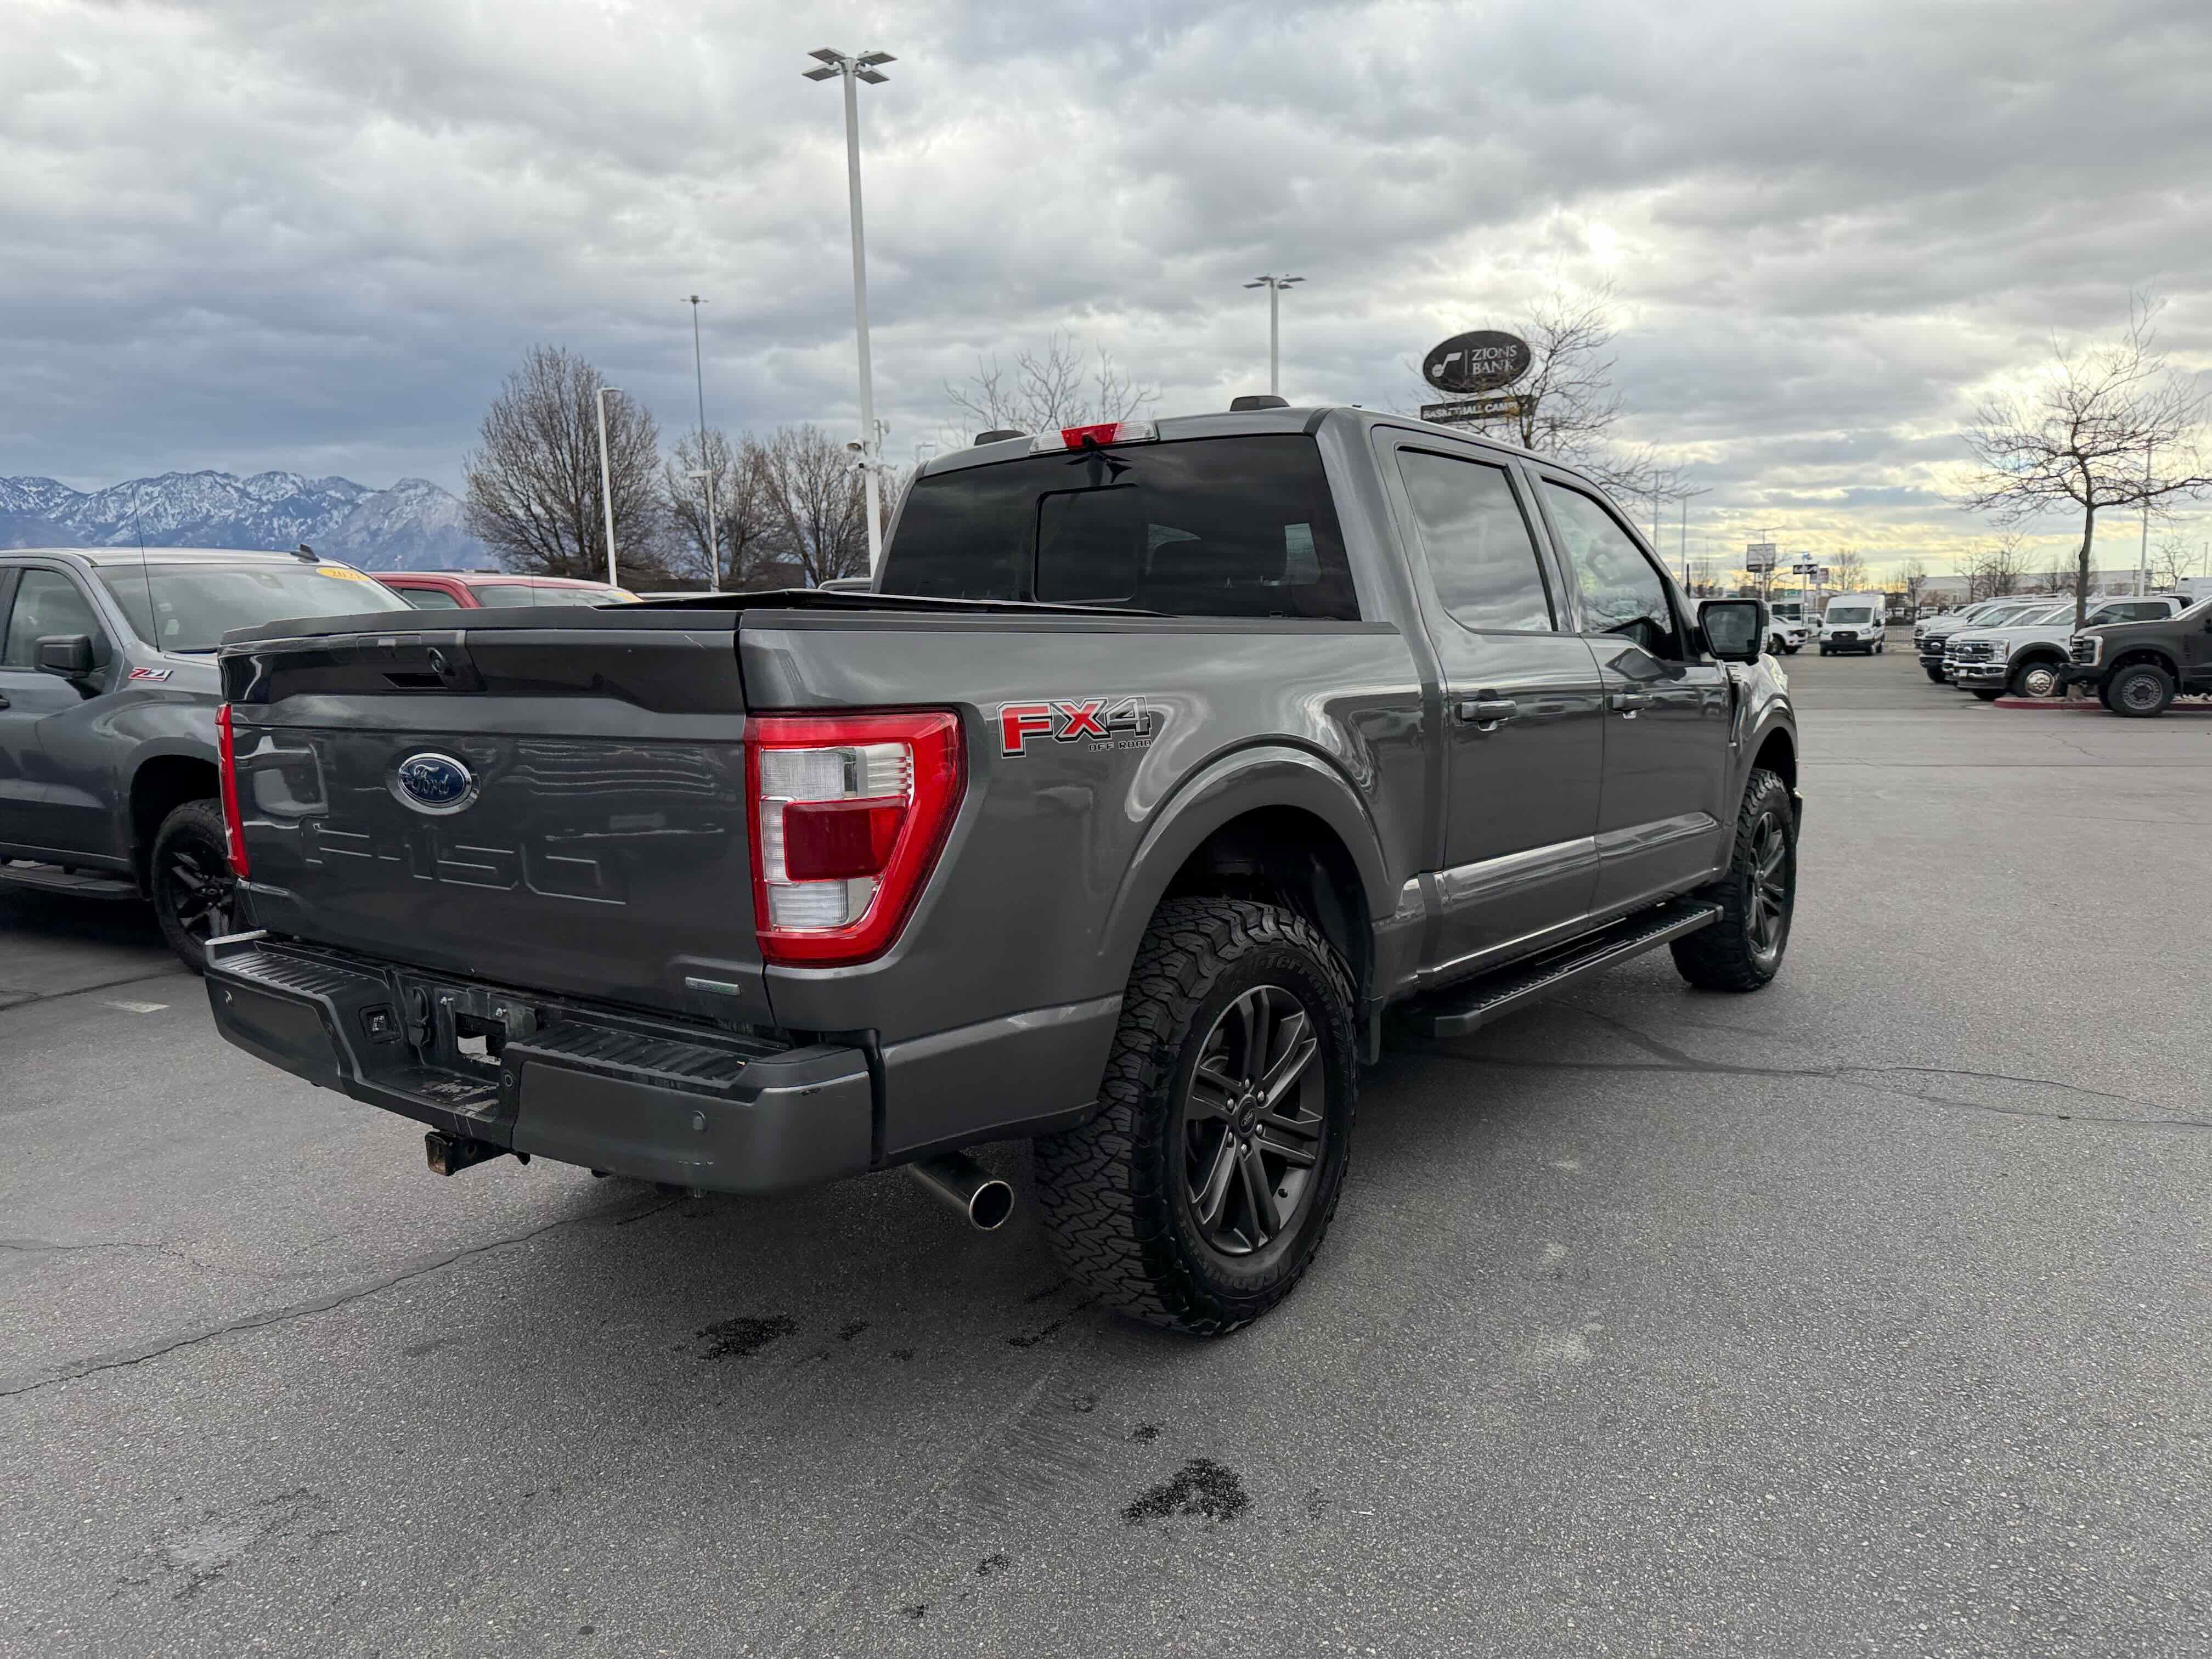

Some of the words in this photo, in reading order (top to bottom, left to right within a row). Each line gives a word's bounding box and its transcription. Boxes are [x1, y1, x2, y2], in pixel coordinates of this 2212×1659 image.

[1471, 345, 1517, 361] ZIONS
[1472, 359, 1514, 375] BANK
[996, 695, 1152, 759] FX4
[1088, 742, 1115, 752] OFF
[1118, 739, 1152, 750] ROAD
[412, 763, 450, 795] Ford
